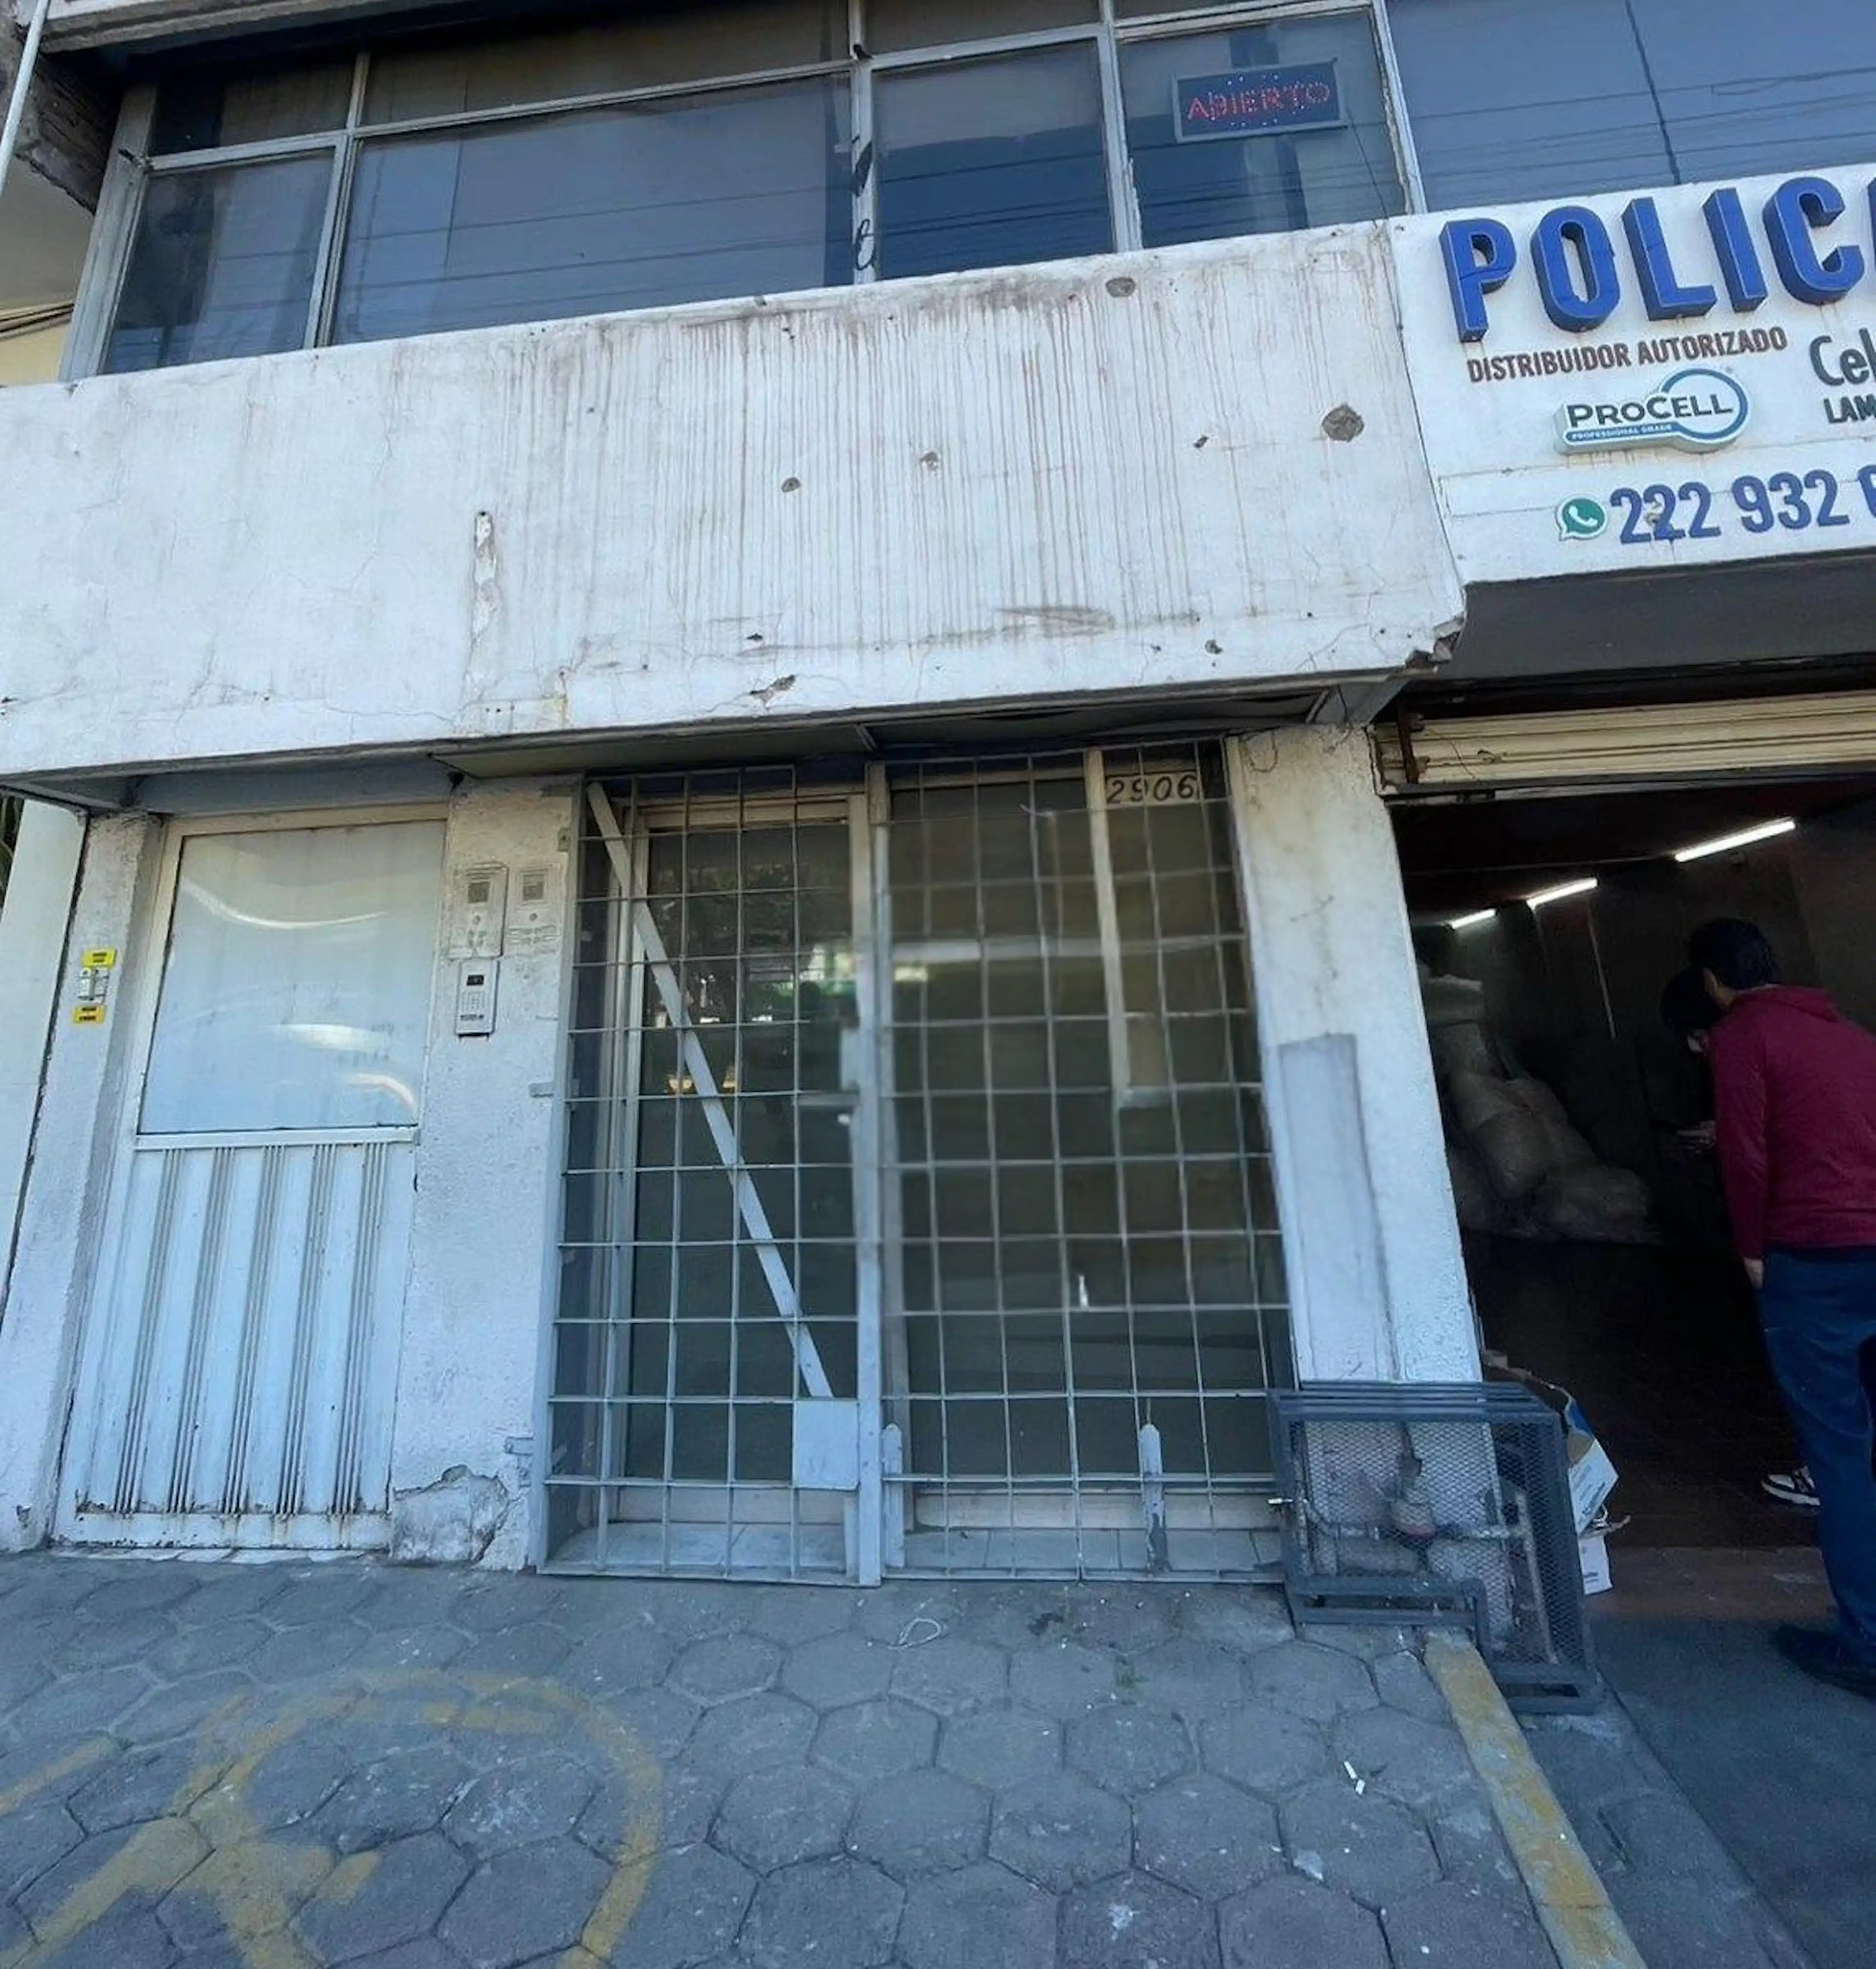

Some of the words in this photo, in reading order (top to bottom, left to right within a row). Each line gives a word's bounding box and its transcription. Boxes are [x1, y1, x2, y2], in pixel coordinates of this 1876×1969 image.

[1187, 80, 1330, 121] ABIERTO
[1439, 177, 1876, 343] POLIC
[1467, 342, 1632, 384] DISTRIBUIDOR
[1638, 326, 1788, 366] AUTORIZADO
[1566, 393, 1733, 427] PROCELL
[1610, 481, 1722, 544] 222
[1731, 469, 1850, 533] 932
[1107, 774, 1198, 804] 2906
